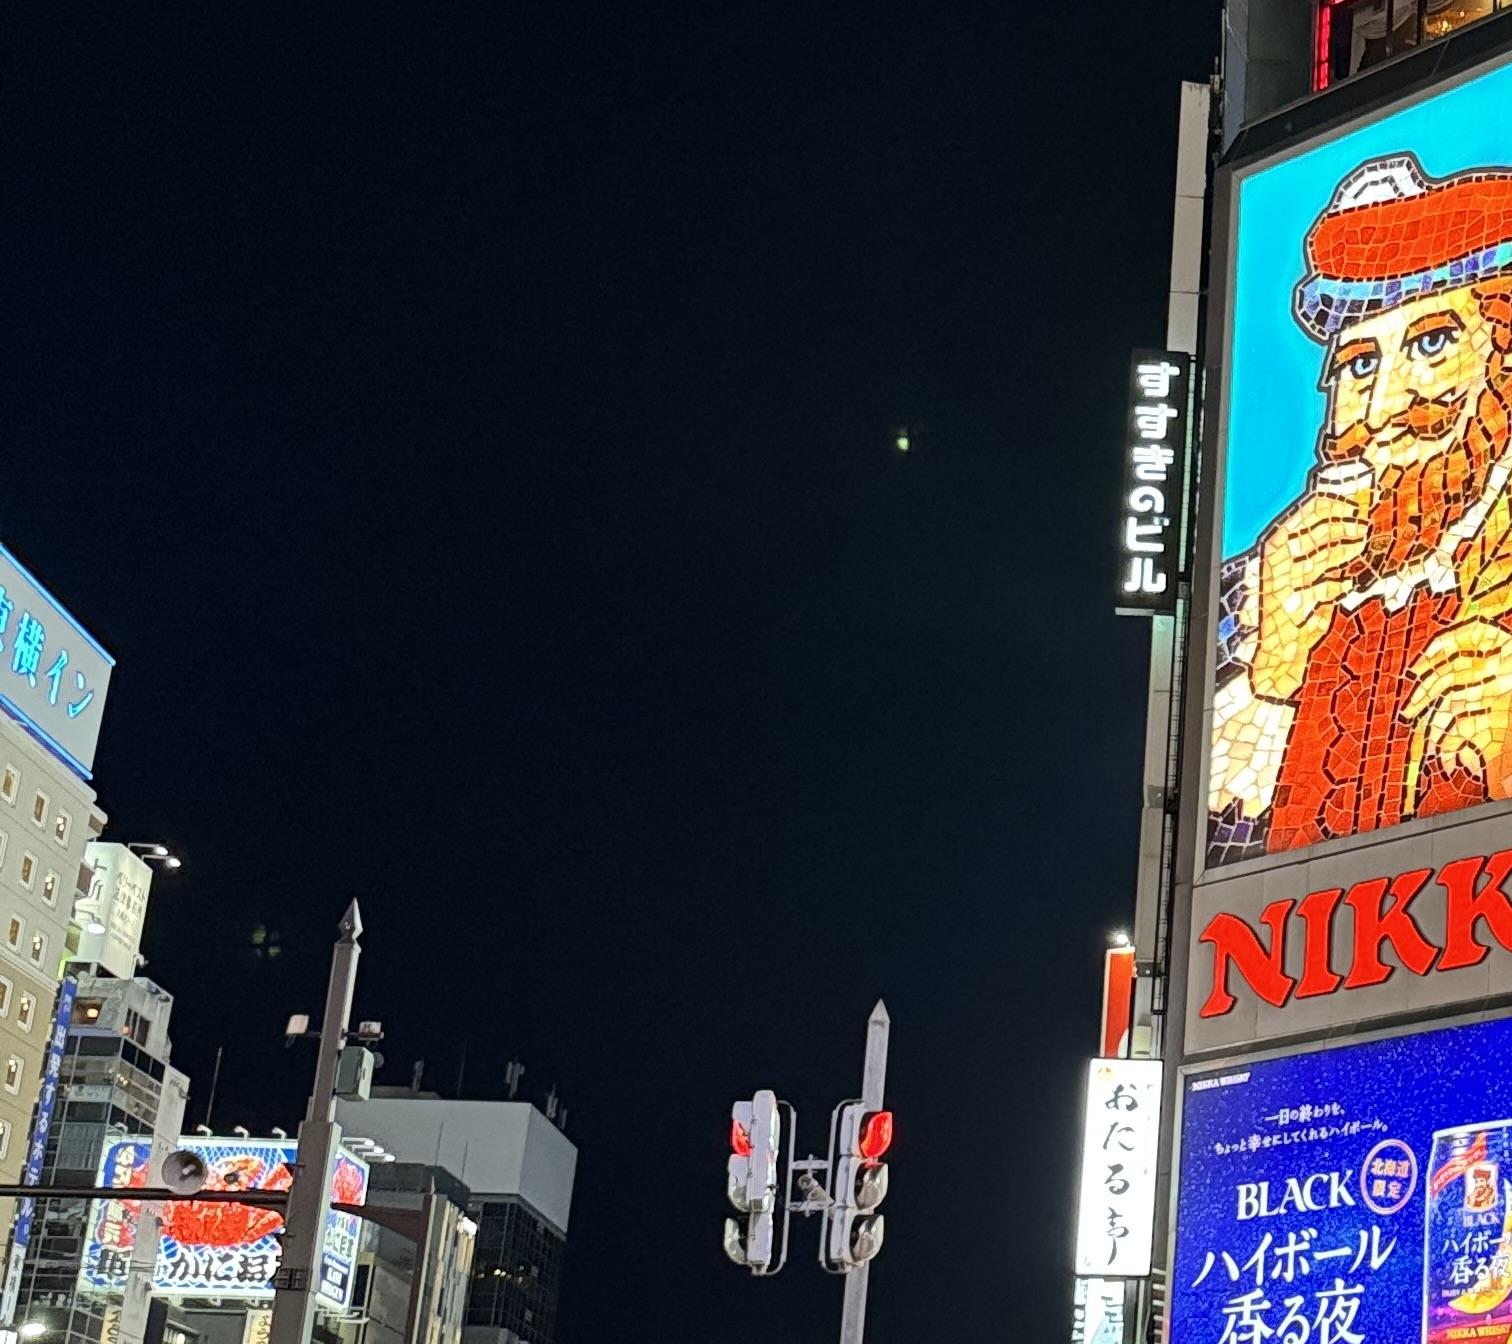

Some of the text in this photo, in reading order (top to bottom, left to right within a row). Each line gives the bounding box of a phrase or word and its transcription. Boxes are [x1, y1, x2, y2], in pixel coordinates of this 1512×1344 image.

[1124, 360, 1180, 593] すすきのビル
[1236, 1169, 1356, 1220] BLACK
[1191, 1225, 1398, 1287] ハイボール
[1450, 1254, 1510, 1285] 香る夜
